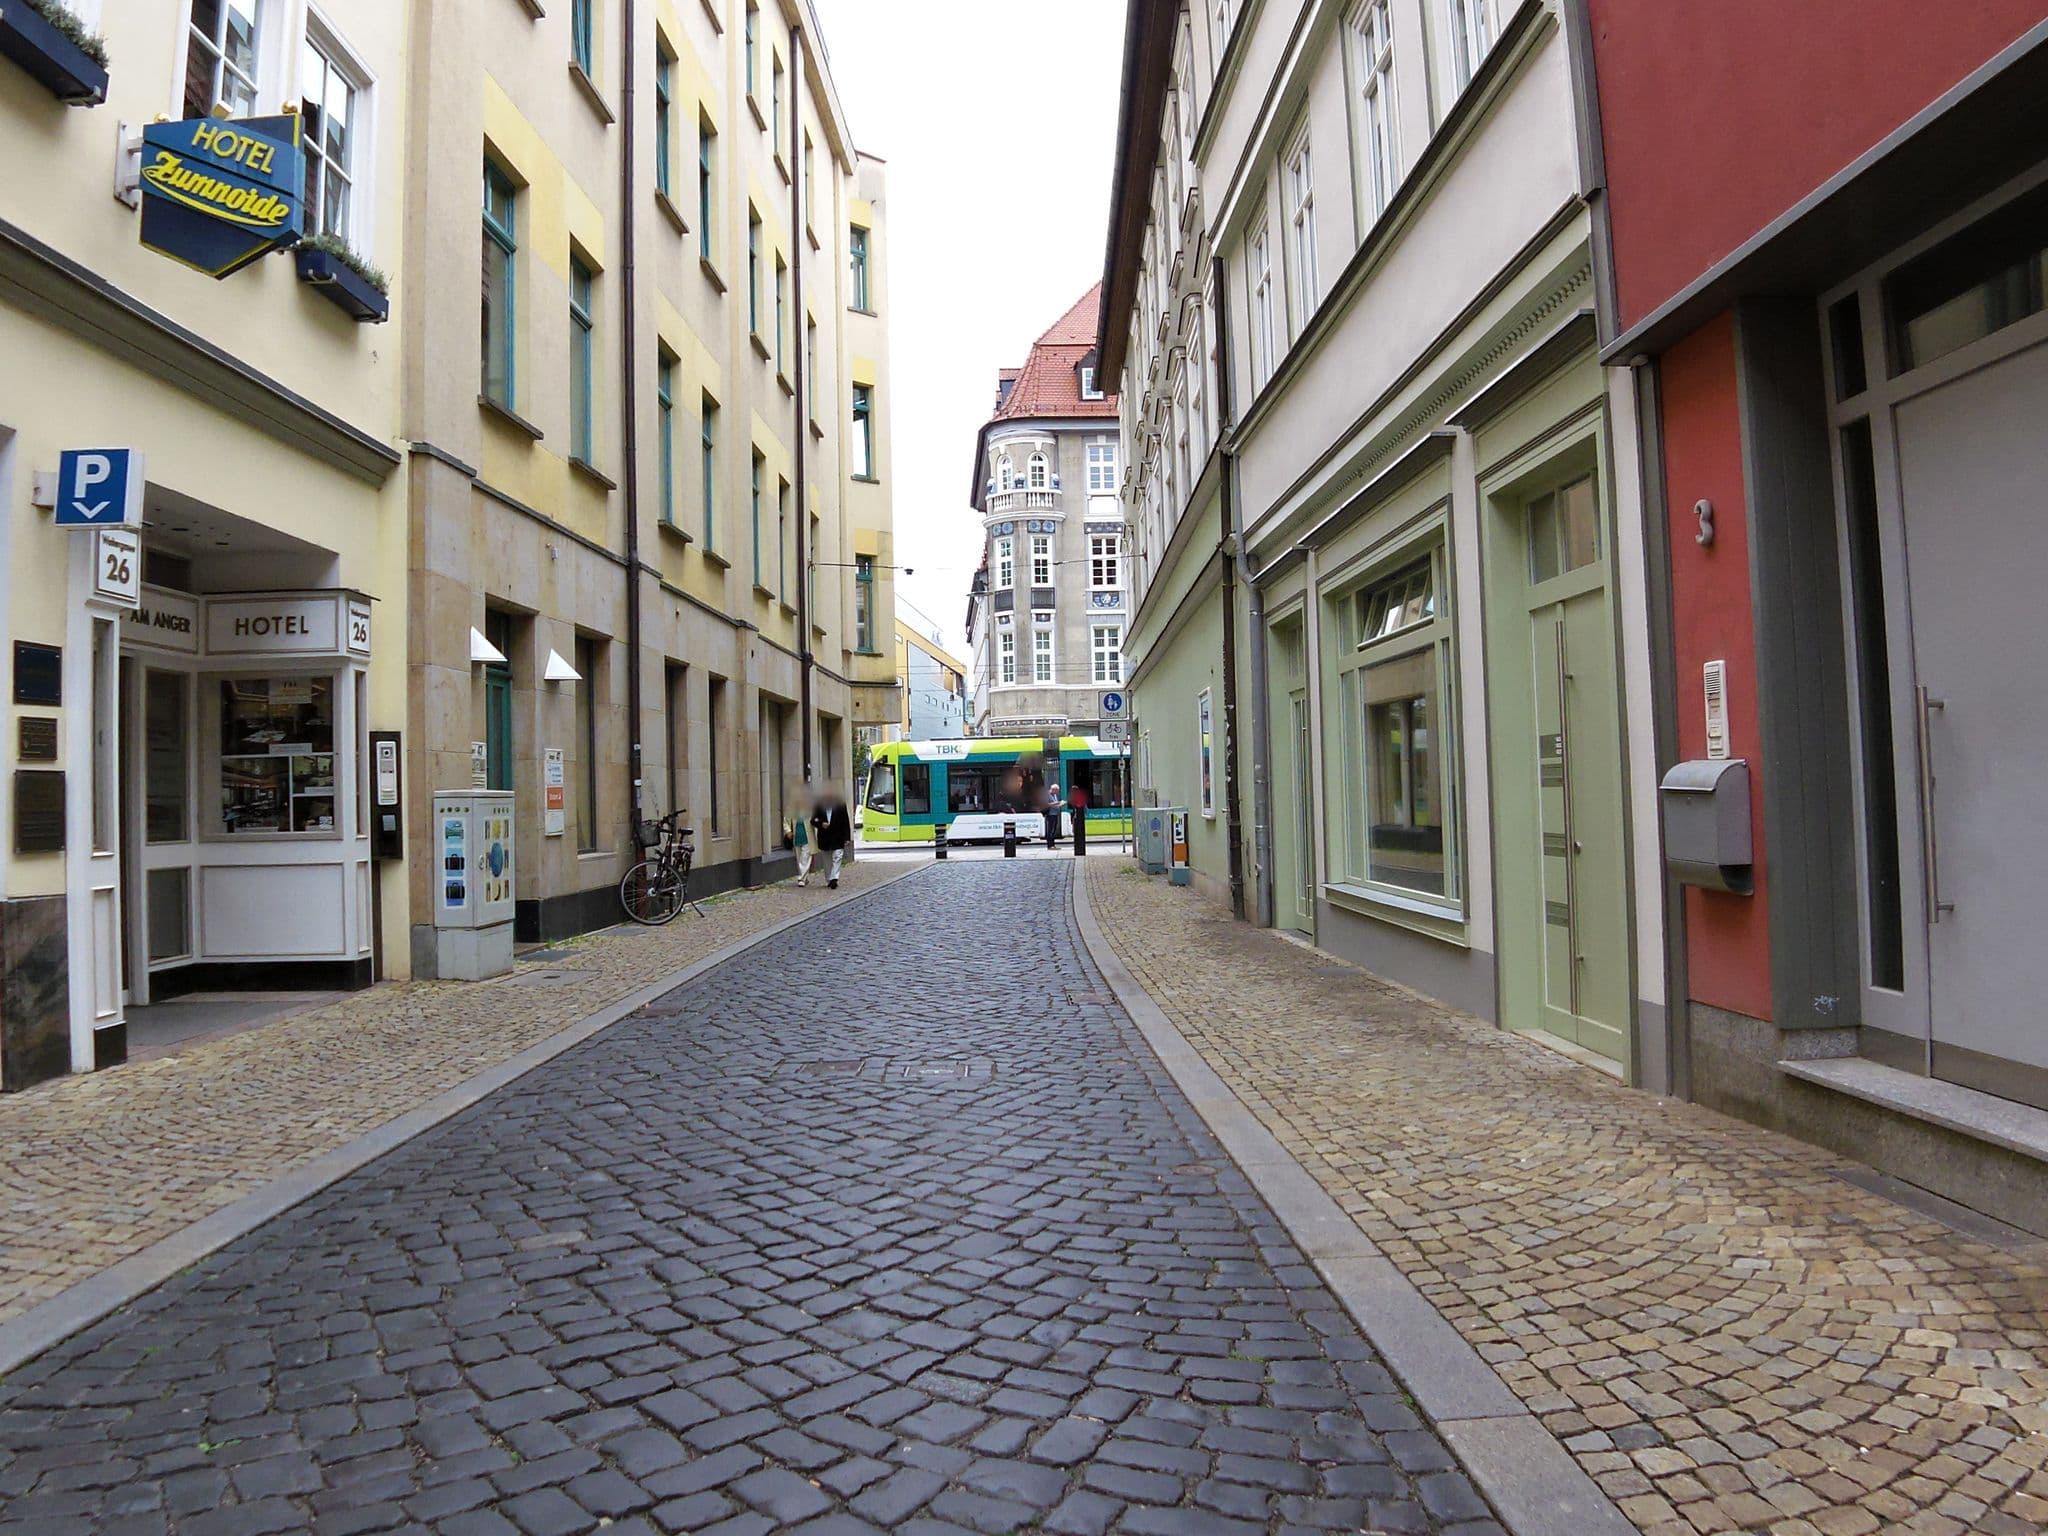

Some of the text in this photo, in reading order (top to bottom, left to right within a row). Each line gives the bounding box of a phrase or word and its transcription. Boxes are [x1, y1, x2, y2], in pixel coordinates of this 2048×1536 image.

[191, 122, 275, 174] HOTEL
[74, 454, 111, 498] P
[1693, 499, 1713, 545] 3
[107, 554, 130, 585] 26
[130, 608, 191, 633] AM ANGER
[235, 615, 309, 636] HOTEL
[353, 622, 367, 642] 26
